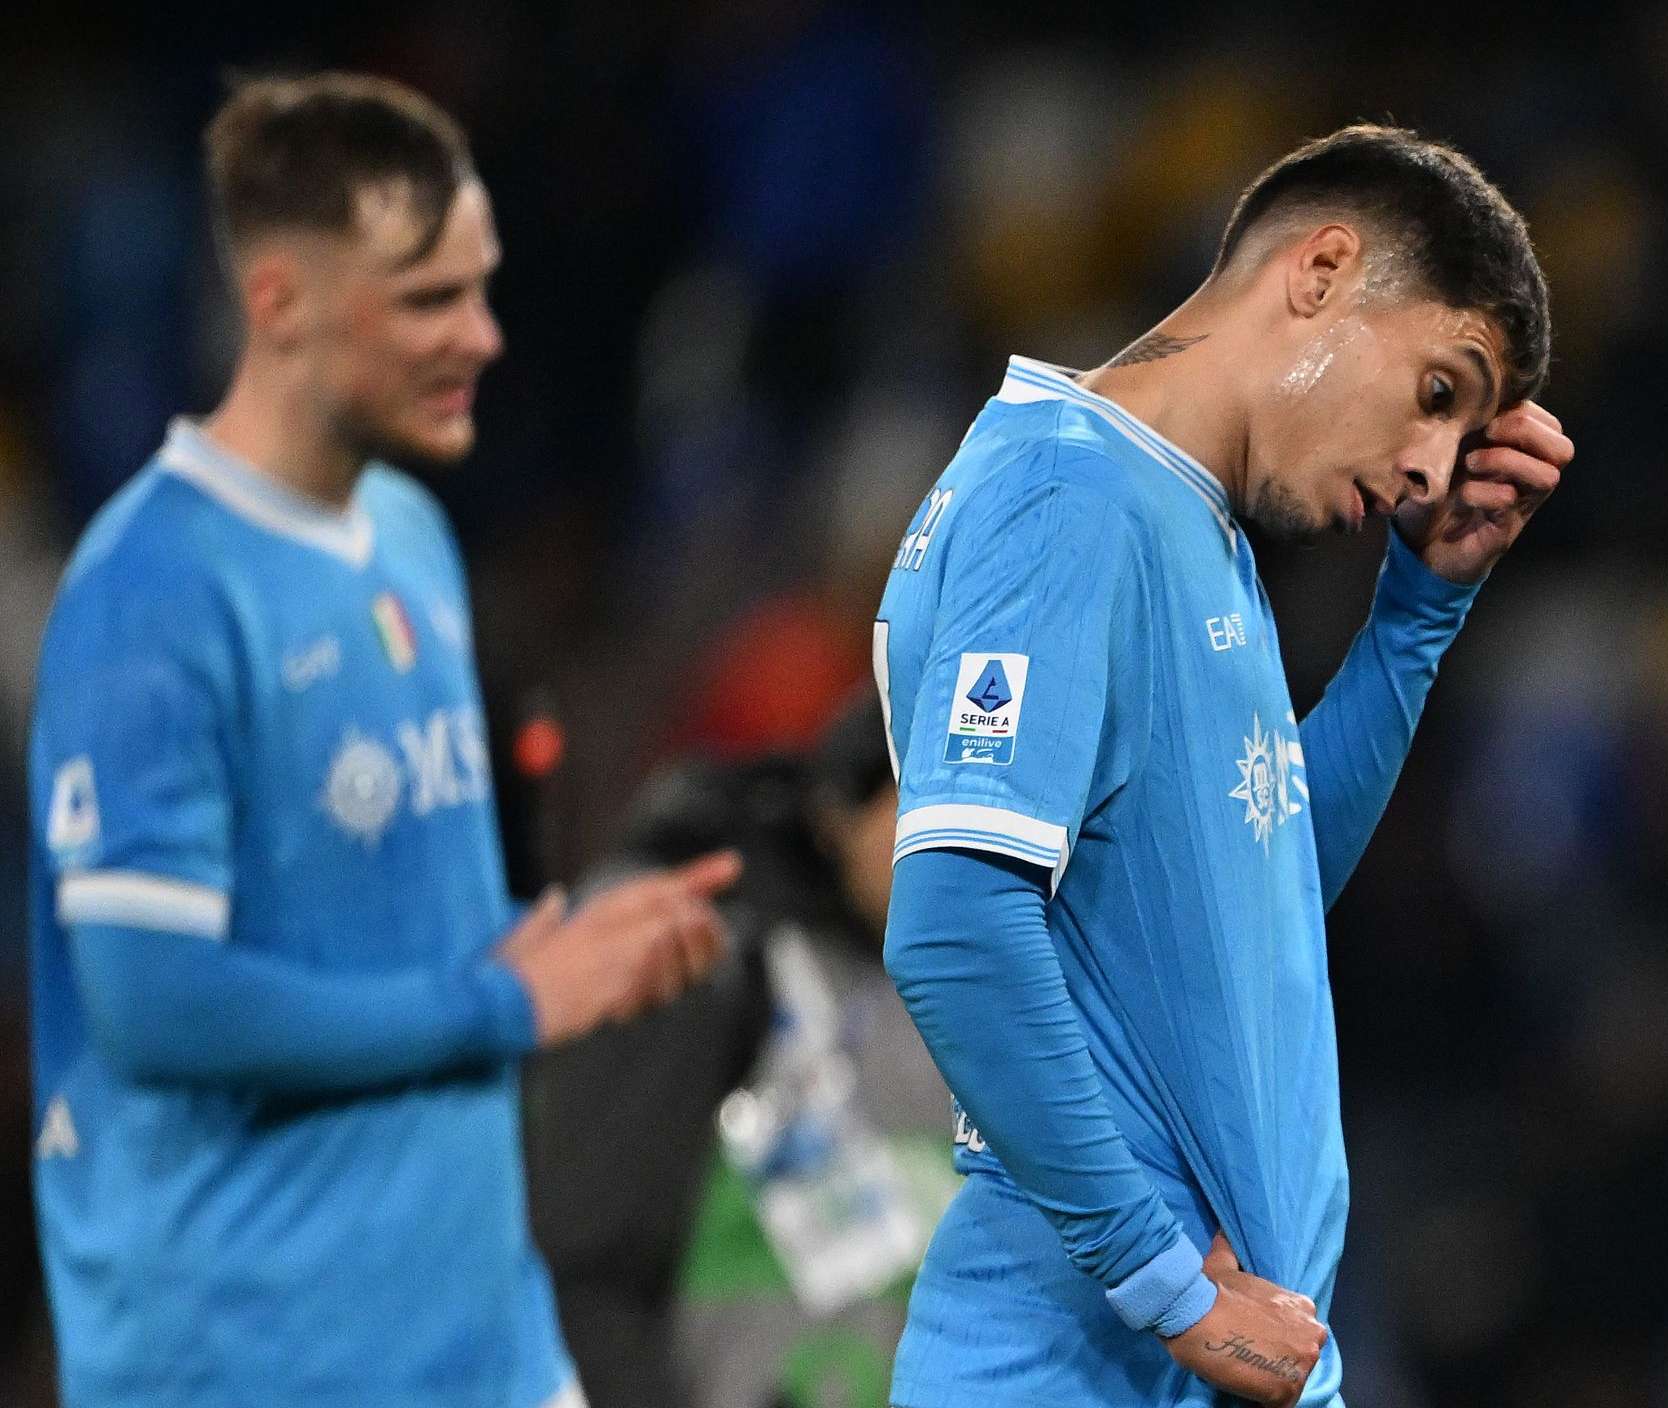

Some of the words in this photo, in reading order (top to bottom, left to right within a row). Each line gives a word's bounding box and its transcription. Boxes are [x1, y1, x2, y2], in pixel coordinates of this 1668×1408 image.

[960, 713, 999, 727] SERIE
[1001, 717, 1010, 727] A
[961, 737, 1002, 748] enilive
